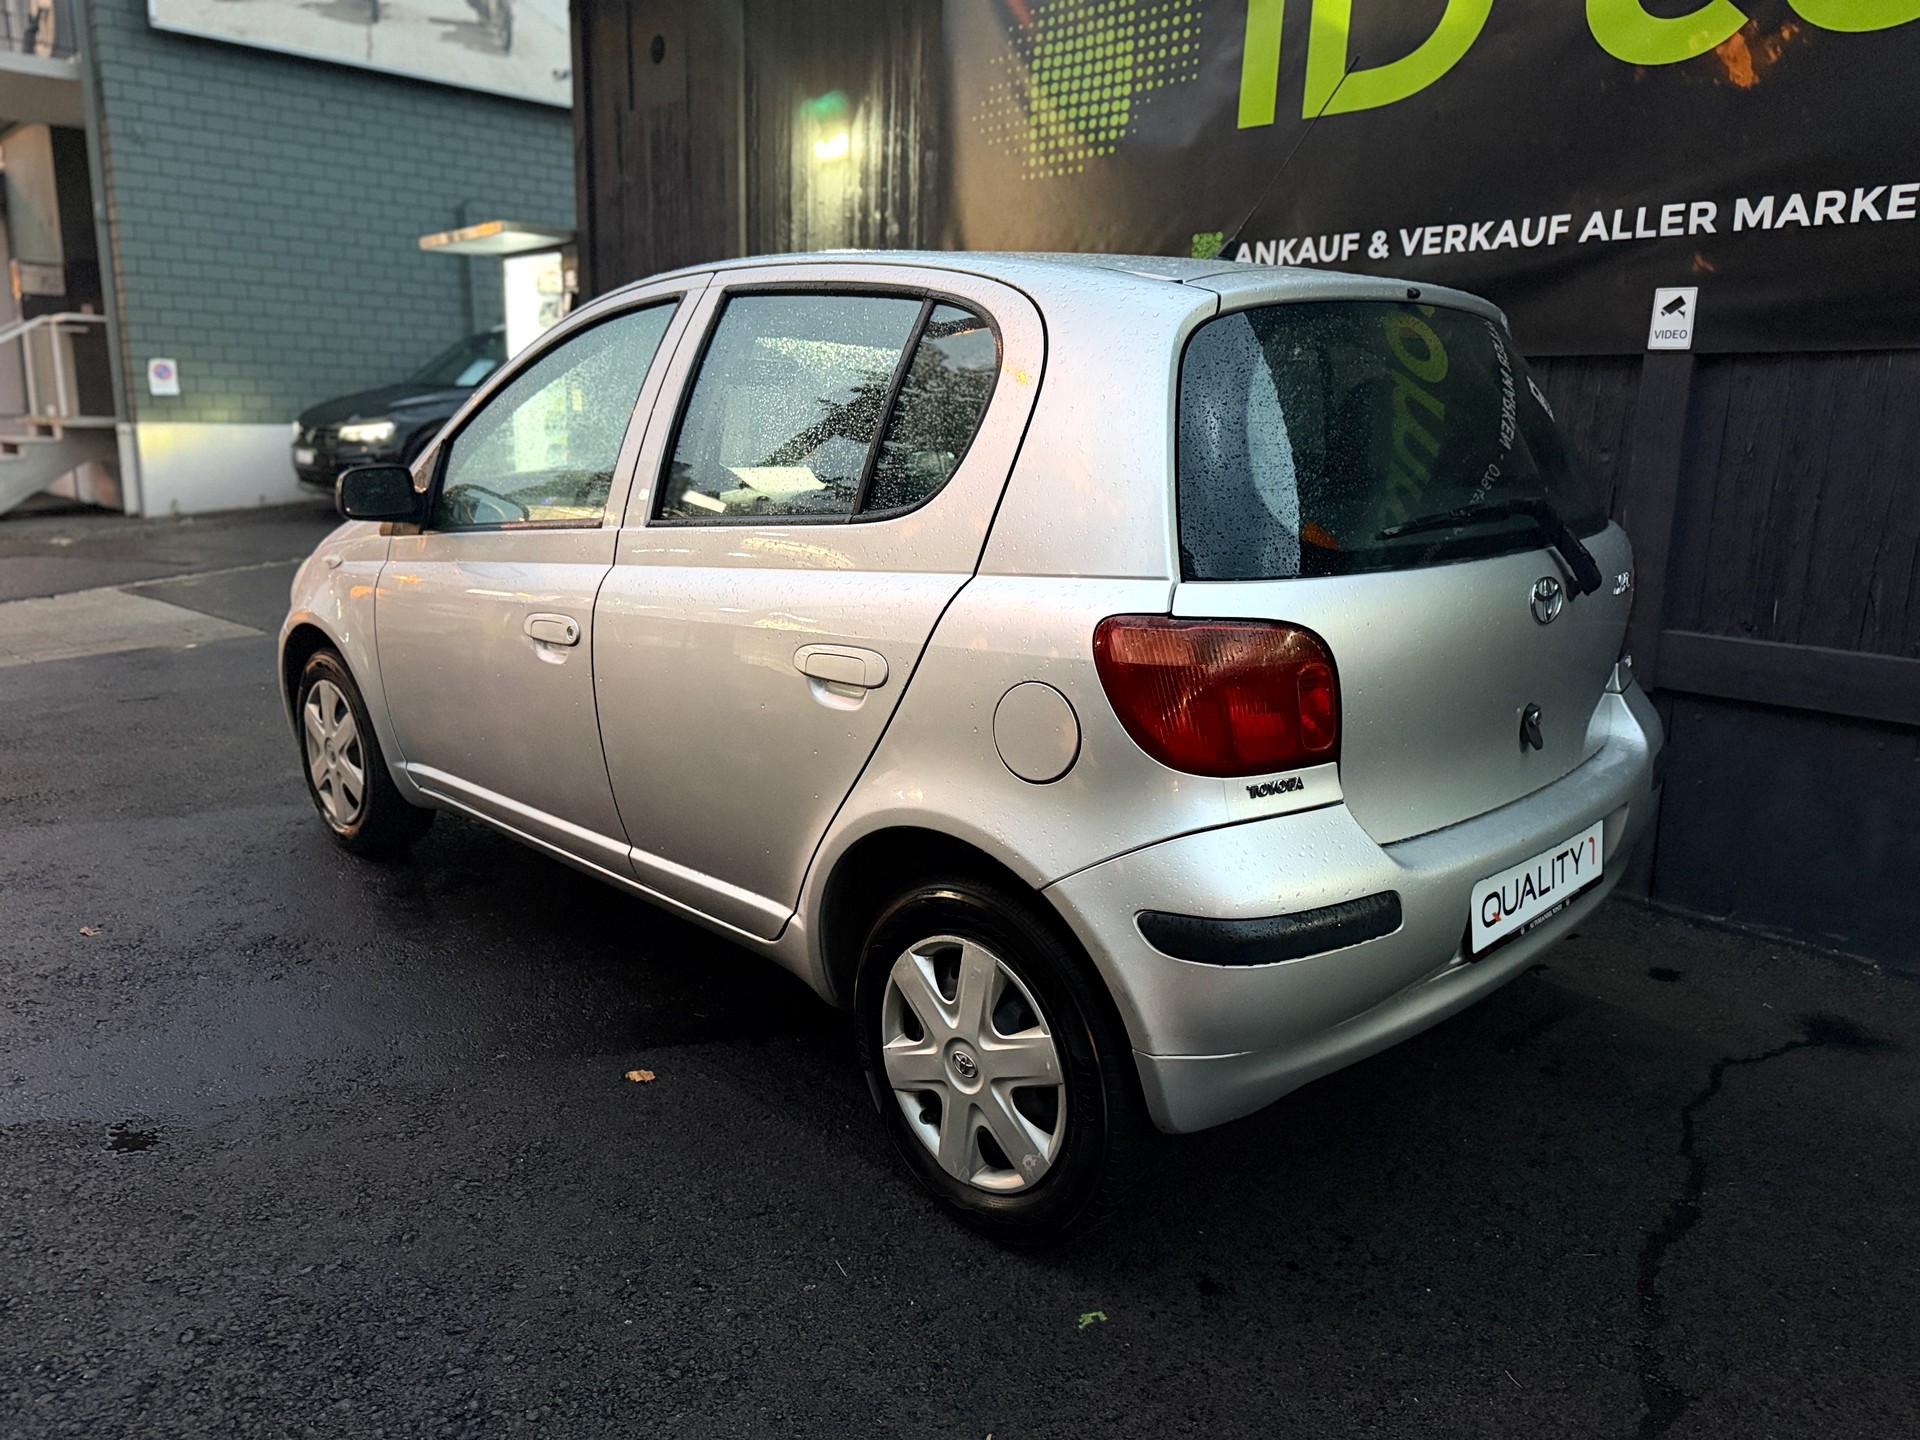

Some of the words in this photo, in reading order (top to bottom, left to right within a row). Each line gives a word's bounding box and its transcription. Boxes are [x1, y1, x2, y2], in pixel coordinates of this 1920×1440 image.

[1235, 233, 1360, 265] ANKAUF
[1368, 230, 1389, 259] &
[1400, 214, 1571, 256] VERKAUF
[1578, 201, 1717, 243] ALLER
[1733, 183, 1920, 231] MARKE
[1654, 329, 1688, 340] VIDEO
[1246, 777, 1304, 799] TOYOTA
